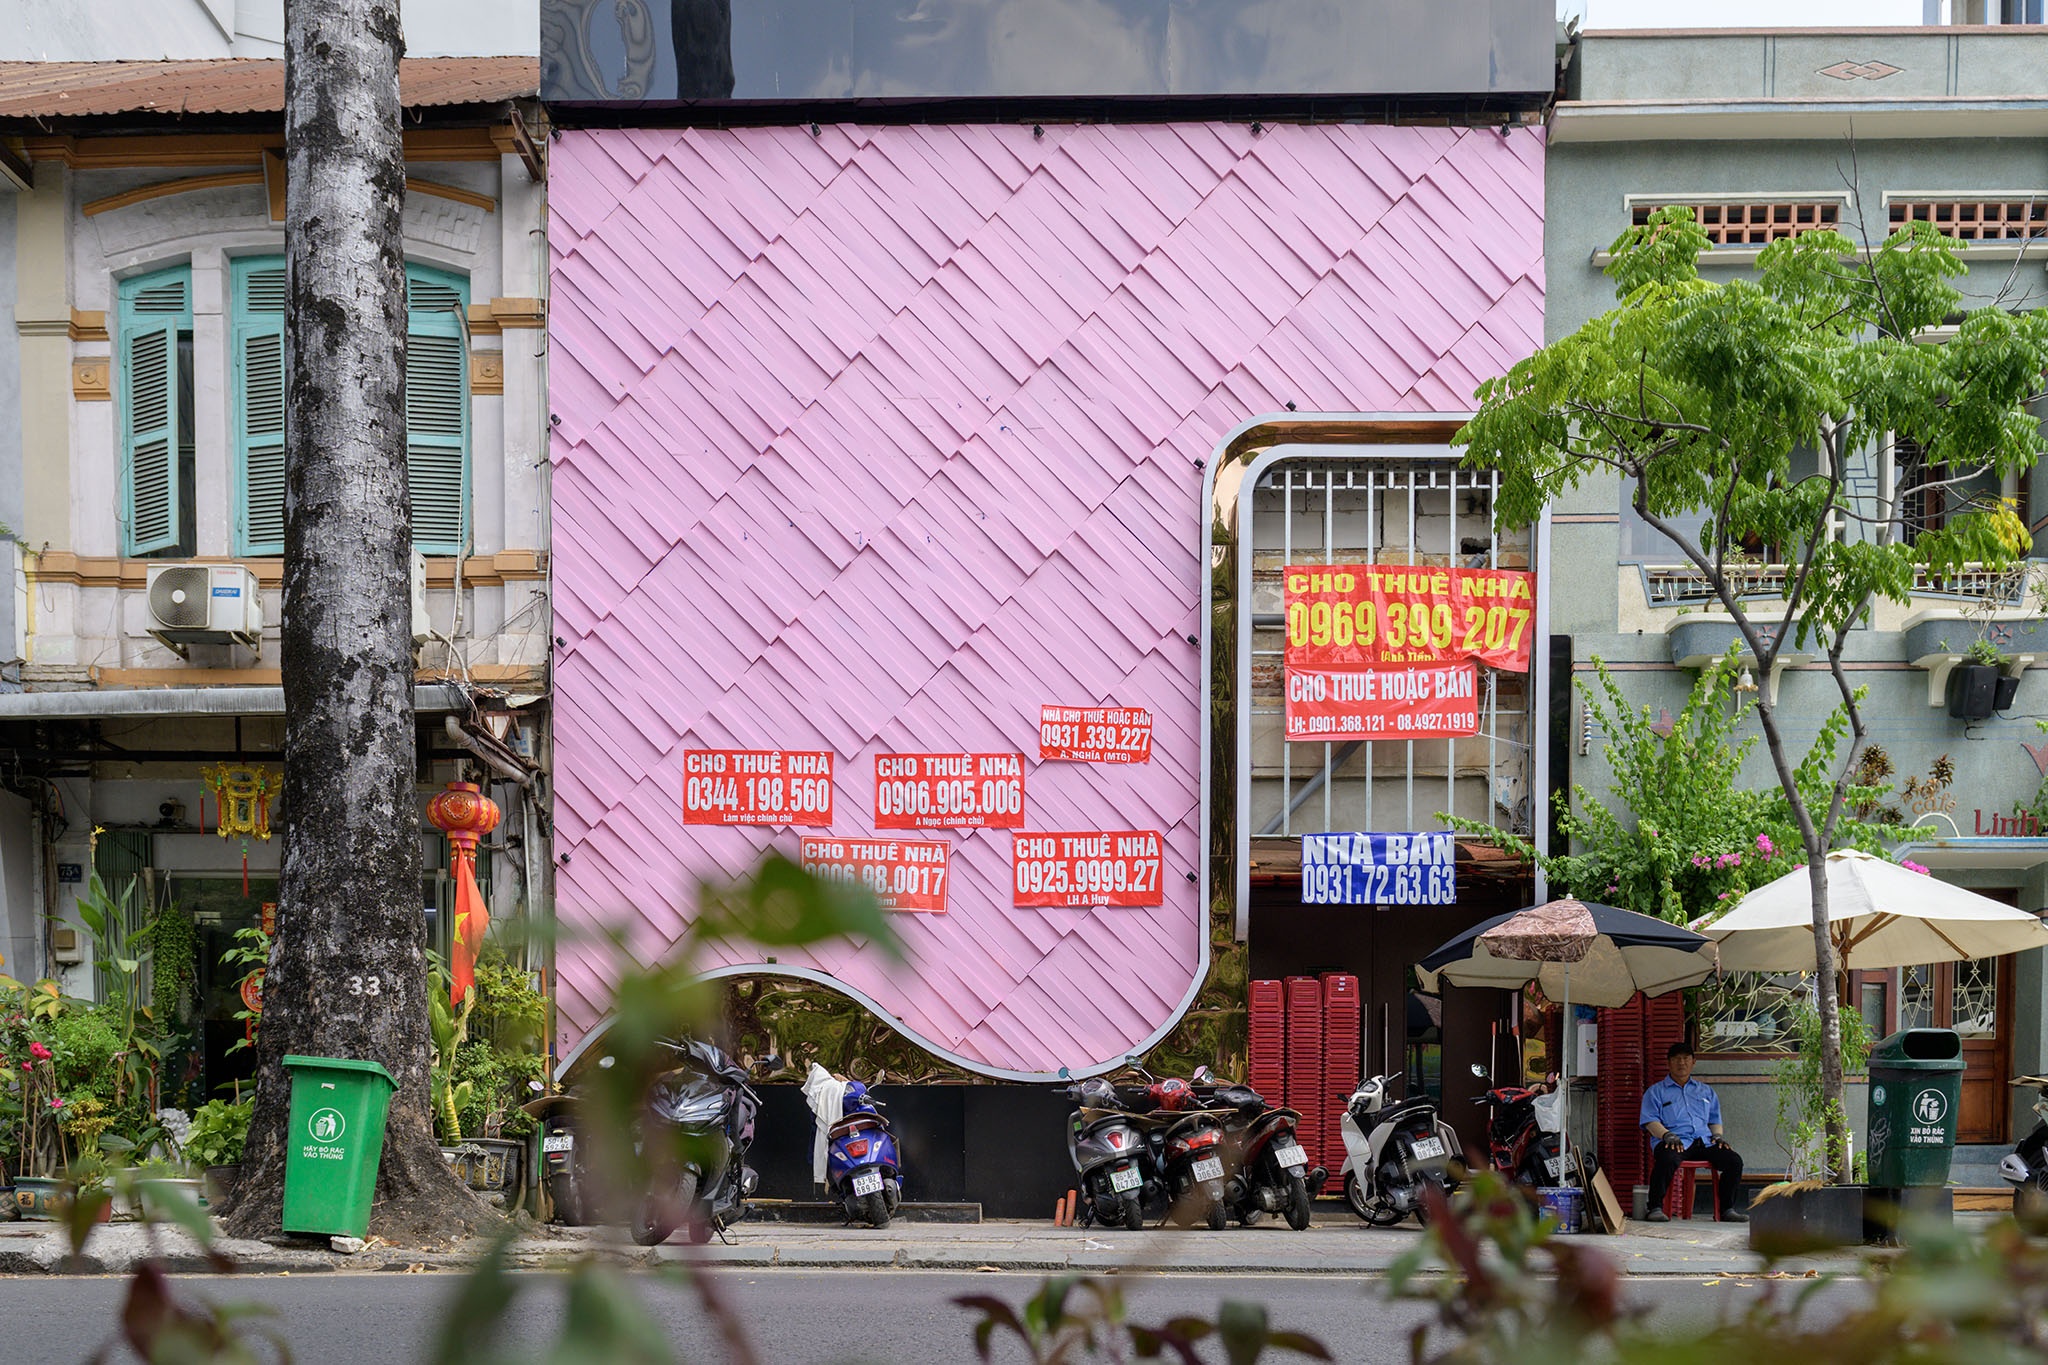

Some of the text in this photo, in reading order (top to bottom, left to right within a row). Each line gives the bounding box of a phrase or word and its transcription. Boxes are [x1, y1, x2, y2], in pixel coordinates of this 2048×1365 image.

[1287, 572, 1531, 600] CHO THUÊ NHÀ
[1289, 600, 1530, 651] 0969 399 207
[1290, 665, 1472, 706] CHO THUÊ HOẶC BÁN
[1042, 708, 1151, 727] NHÀ CHO THUÊ HOẶC BÁN
[1288, 716, 1306, 733] LH:
[1309, 714, 1385, 732] 0901.368.121
[1397, 712, 1475, 731] 08.4927.1919
[1041, 723, 1151, 751] 0931.339.227
[687, 751, 830, 775] CHO THUÊ NHÀ
[878, 753, 1021, 777] CHO THUÊ NHÀ
[1060, 750, 1069, 759] A.
[1103, 752, 1131, 763] (MTG)
[687, 776, 830, 813] 0344.198.560
[878, 779, 1021, 815] 0906.905.006
[915, 816, 921, 826] A
[922, 817, 942, 827] Ngọc
[943, 815, 966, 826] (chính
[1974, 809, 2039, 836] Linh
[804, 842, 945, 863] CHO THUÊ NHÀ
[1016, 833, 1159, 859] CHO THUÊ NHÀ
[1303, 832, 1455, 866] NHÀ BÁN
[1016, 859, 1160, 893] 0925.9999.27
[1303, 864, 1455, 905] 0931.72.63.63
[1067, 893, 1110, 906] LH A Huy
[349, 975, 380, 996] 33
[1910, 1125, 1945, 1135] XIN BỎ RÁC
[1910, 1135, 1944, 1144] VÀO THÙNG
